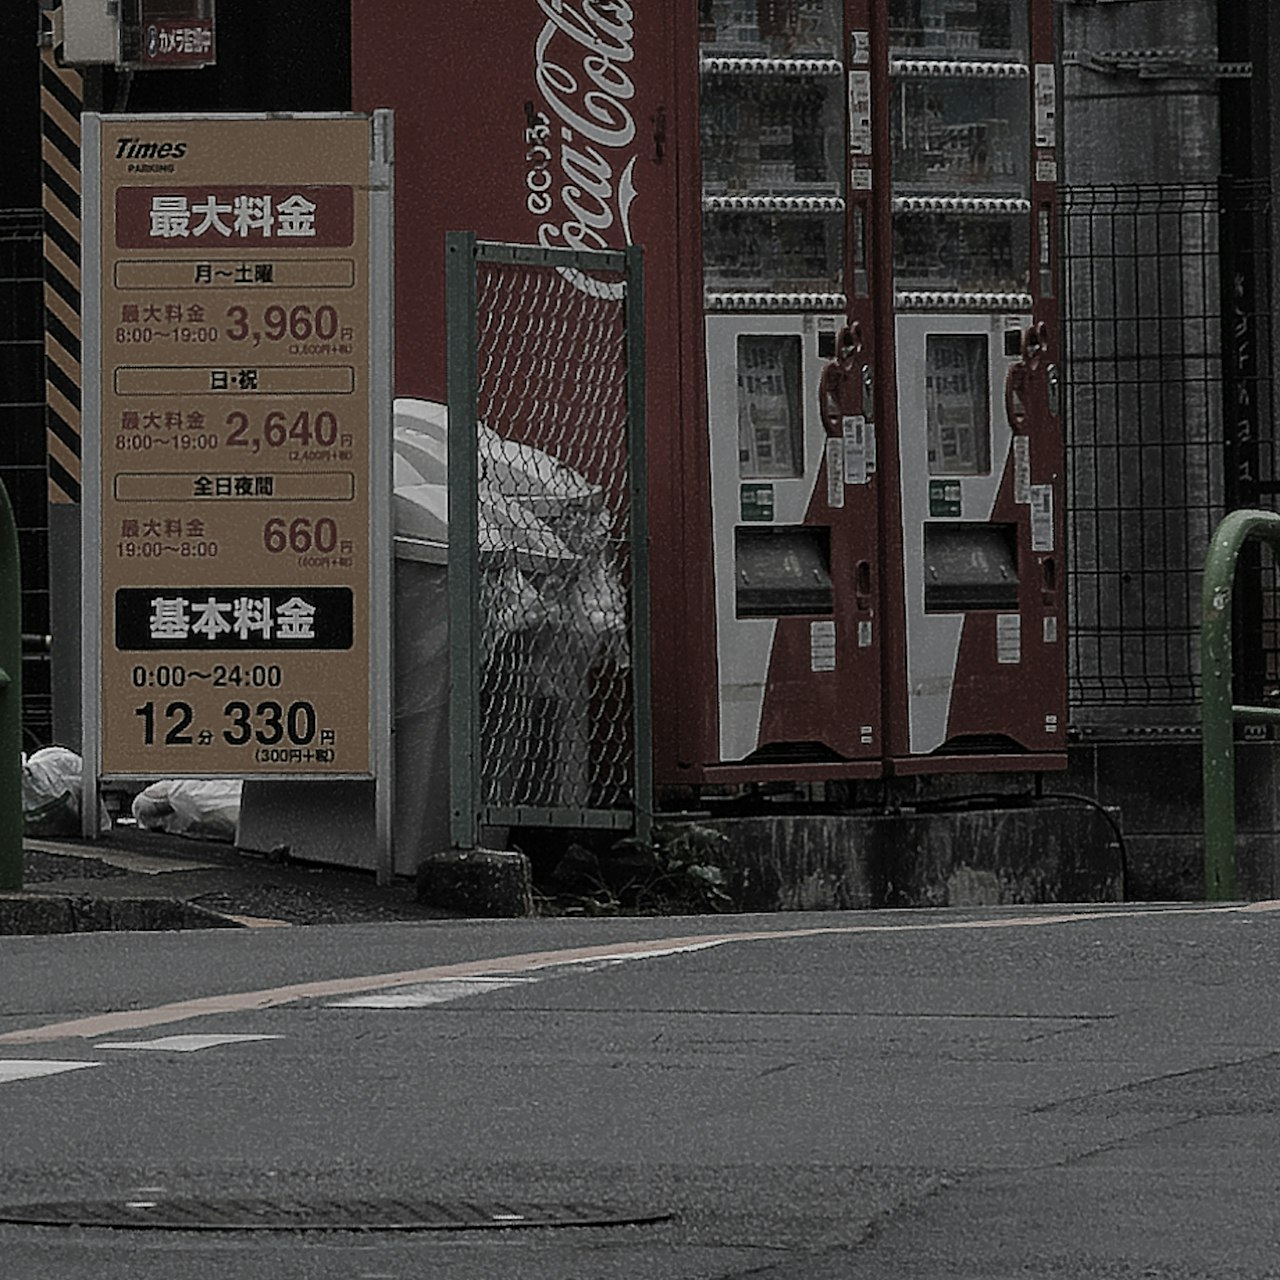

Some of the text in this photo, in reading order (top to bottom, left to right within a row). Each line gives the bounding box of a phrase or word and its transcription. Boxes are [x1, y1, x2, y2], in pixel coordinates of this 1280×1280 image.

[114, 138, 188, 159] Times
[149, 195, 317, 239] 最大料金
[121, 305, 205, 322] 最大料金
[121, 411, 205, 430] 最大料金
[193, 477, 273, 496] 全日夜間
[121, 519, 205, 538] 最大料金
[149, 597, 317, 640] 基本料金
